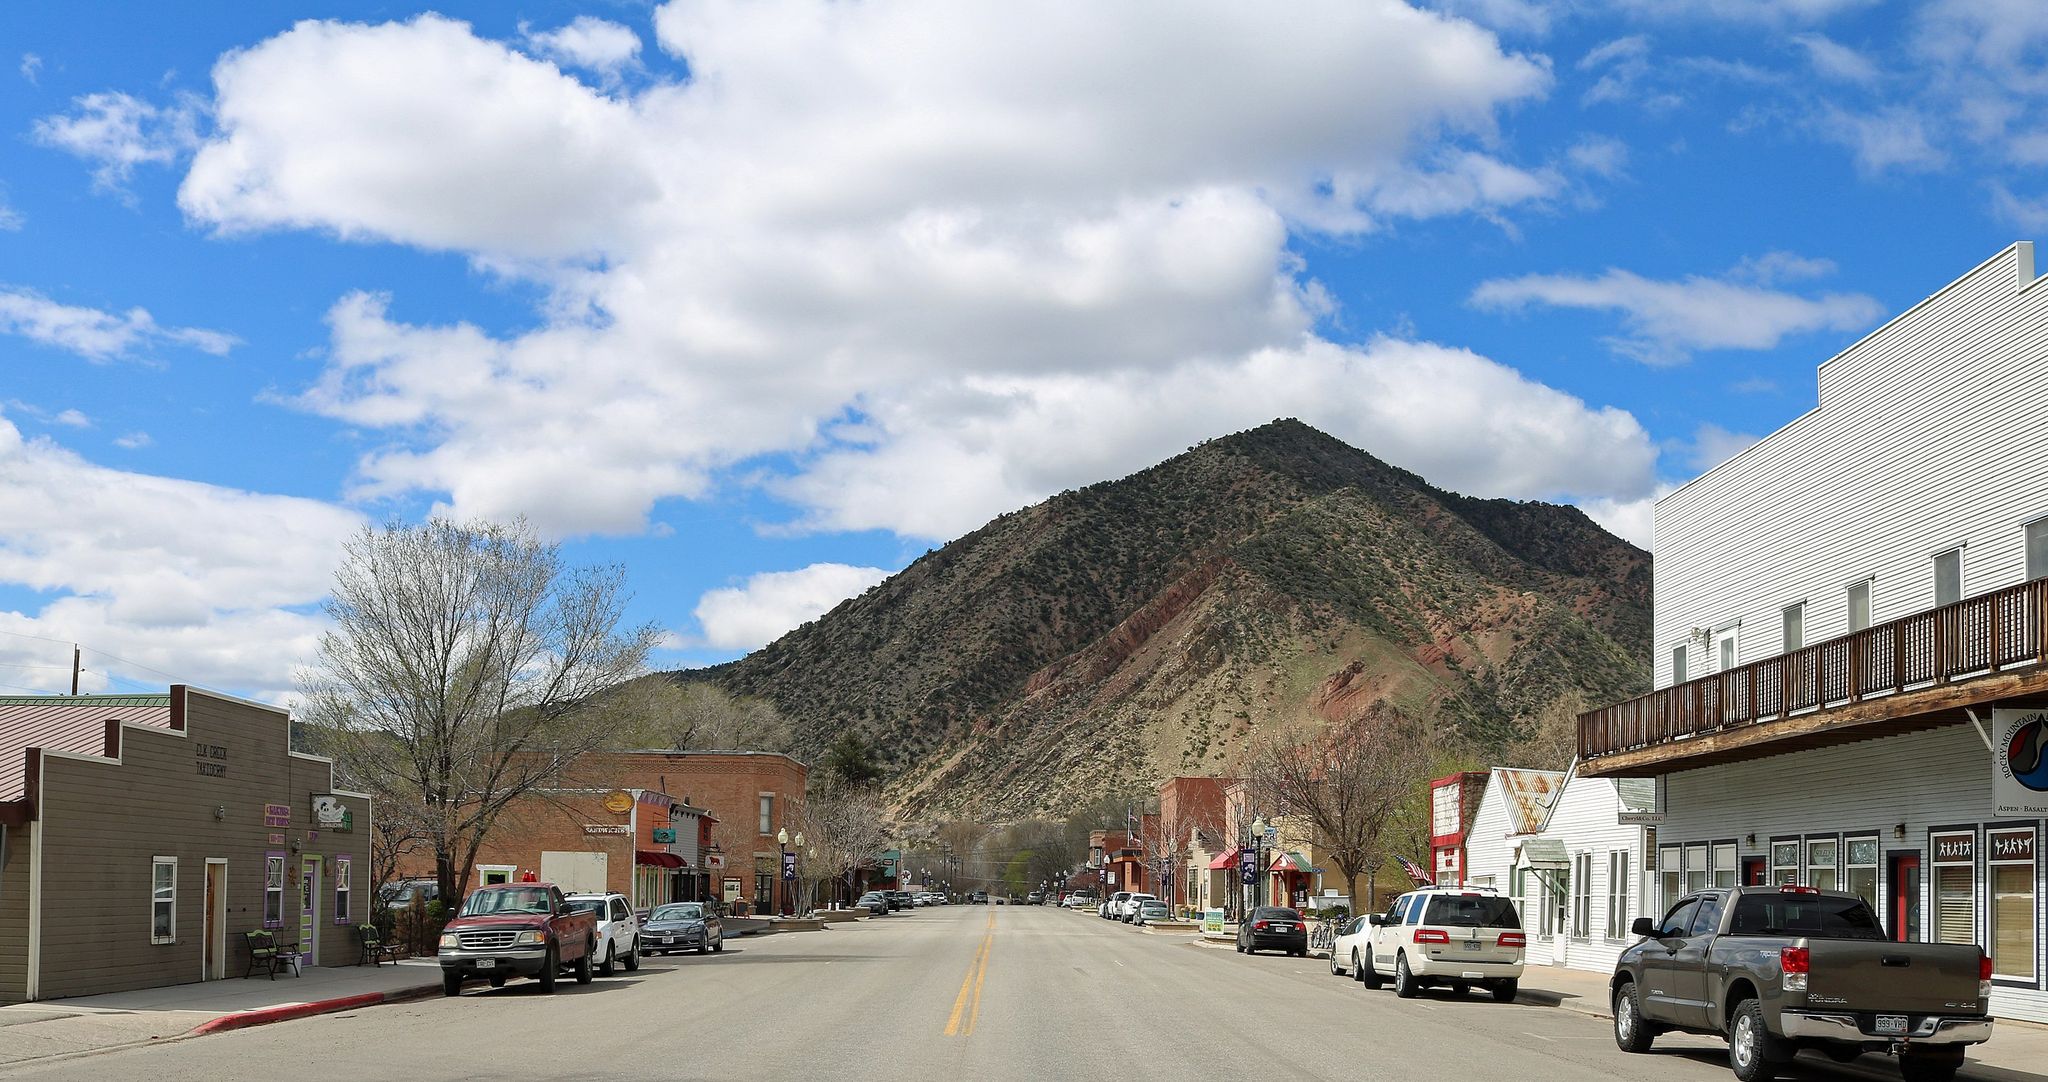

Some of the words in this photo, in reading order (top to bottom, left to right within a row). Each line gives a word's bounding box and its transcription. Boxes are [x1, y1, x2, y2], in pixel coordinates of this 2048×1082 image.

[2001, 712, 2037, 748] MOUNTAIN
[1999, 748, 2012, 780] ROCKY
[2024, 805, 2047, 813] BASALT
